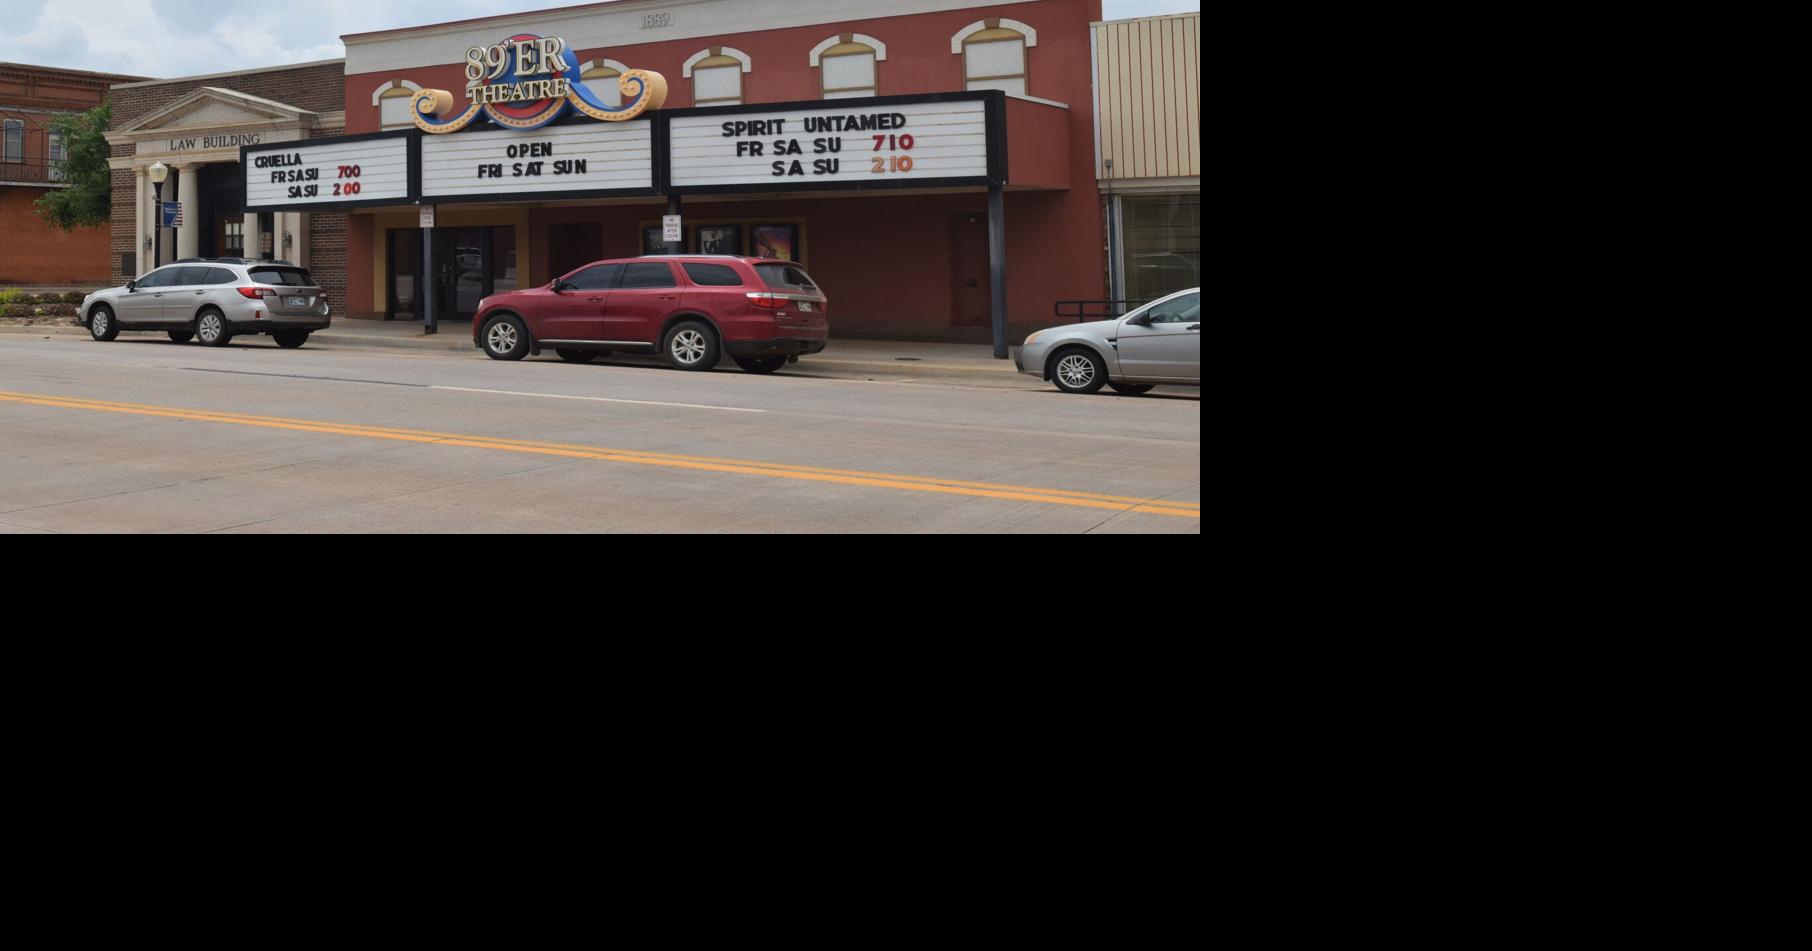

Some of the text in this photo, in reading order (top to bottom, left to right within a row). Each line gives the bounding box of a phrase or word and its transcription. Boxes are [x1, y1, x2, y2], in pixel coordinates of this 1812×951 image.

[465, 36, 571, 80] 89'ER
[466, 78, 569, 105] THEATRE
[722, 112, 906, 138] SPIRIT UNTAMED
[170, 134, 260, 151] LAW BUILDING
[506, 141, 552, 159] OPEN
[736, 133, 914, 157] FR SA SU 710
[254, 153, 302, 168] CRUELLA
[478, 159, 587, 179] FRI SAT SUN
[771, 155, 913, 177] SA SU 210
[337, 164, 361, 178] 700
[333, 181, 361, 196] 200
